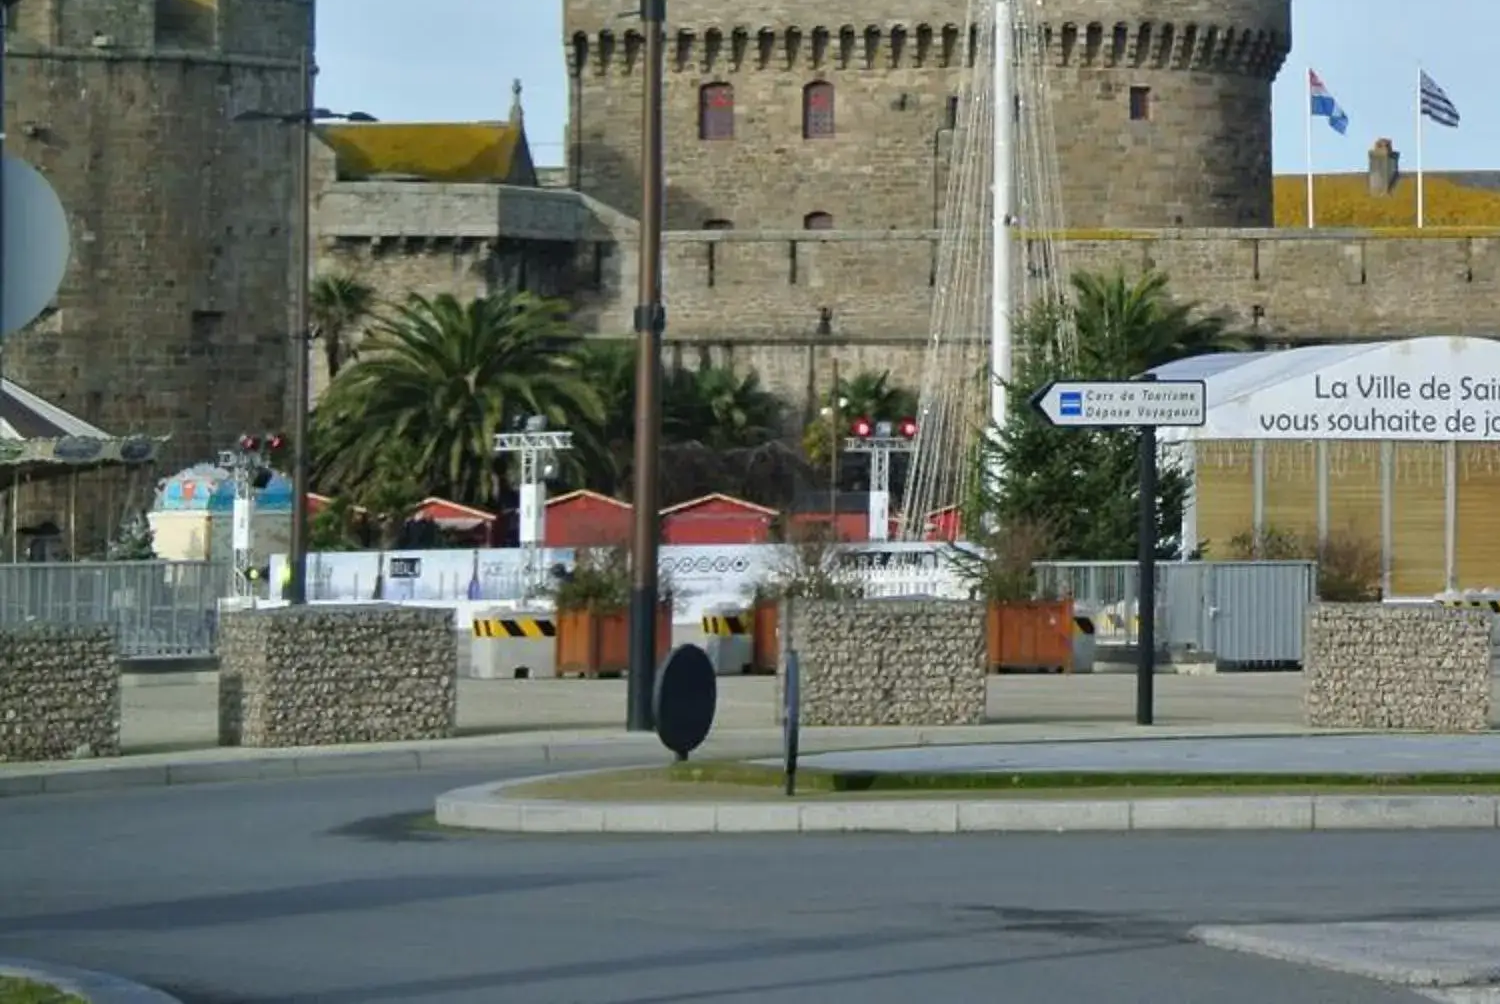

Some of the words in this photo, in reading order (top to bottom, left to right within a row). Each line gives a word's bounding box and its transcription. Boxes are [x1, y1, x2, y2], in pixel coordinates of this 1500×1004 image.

[1315, 374, 1348, 399] La
[1357, 374, 1411, 399] Ville
[1419, 375, 1450, 400] de
[1260, 412, 1319, 431] vous
[1327, 407, 1437, 432] souhaite
[1445, 409, 1476, 433] de
